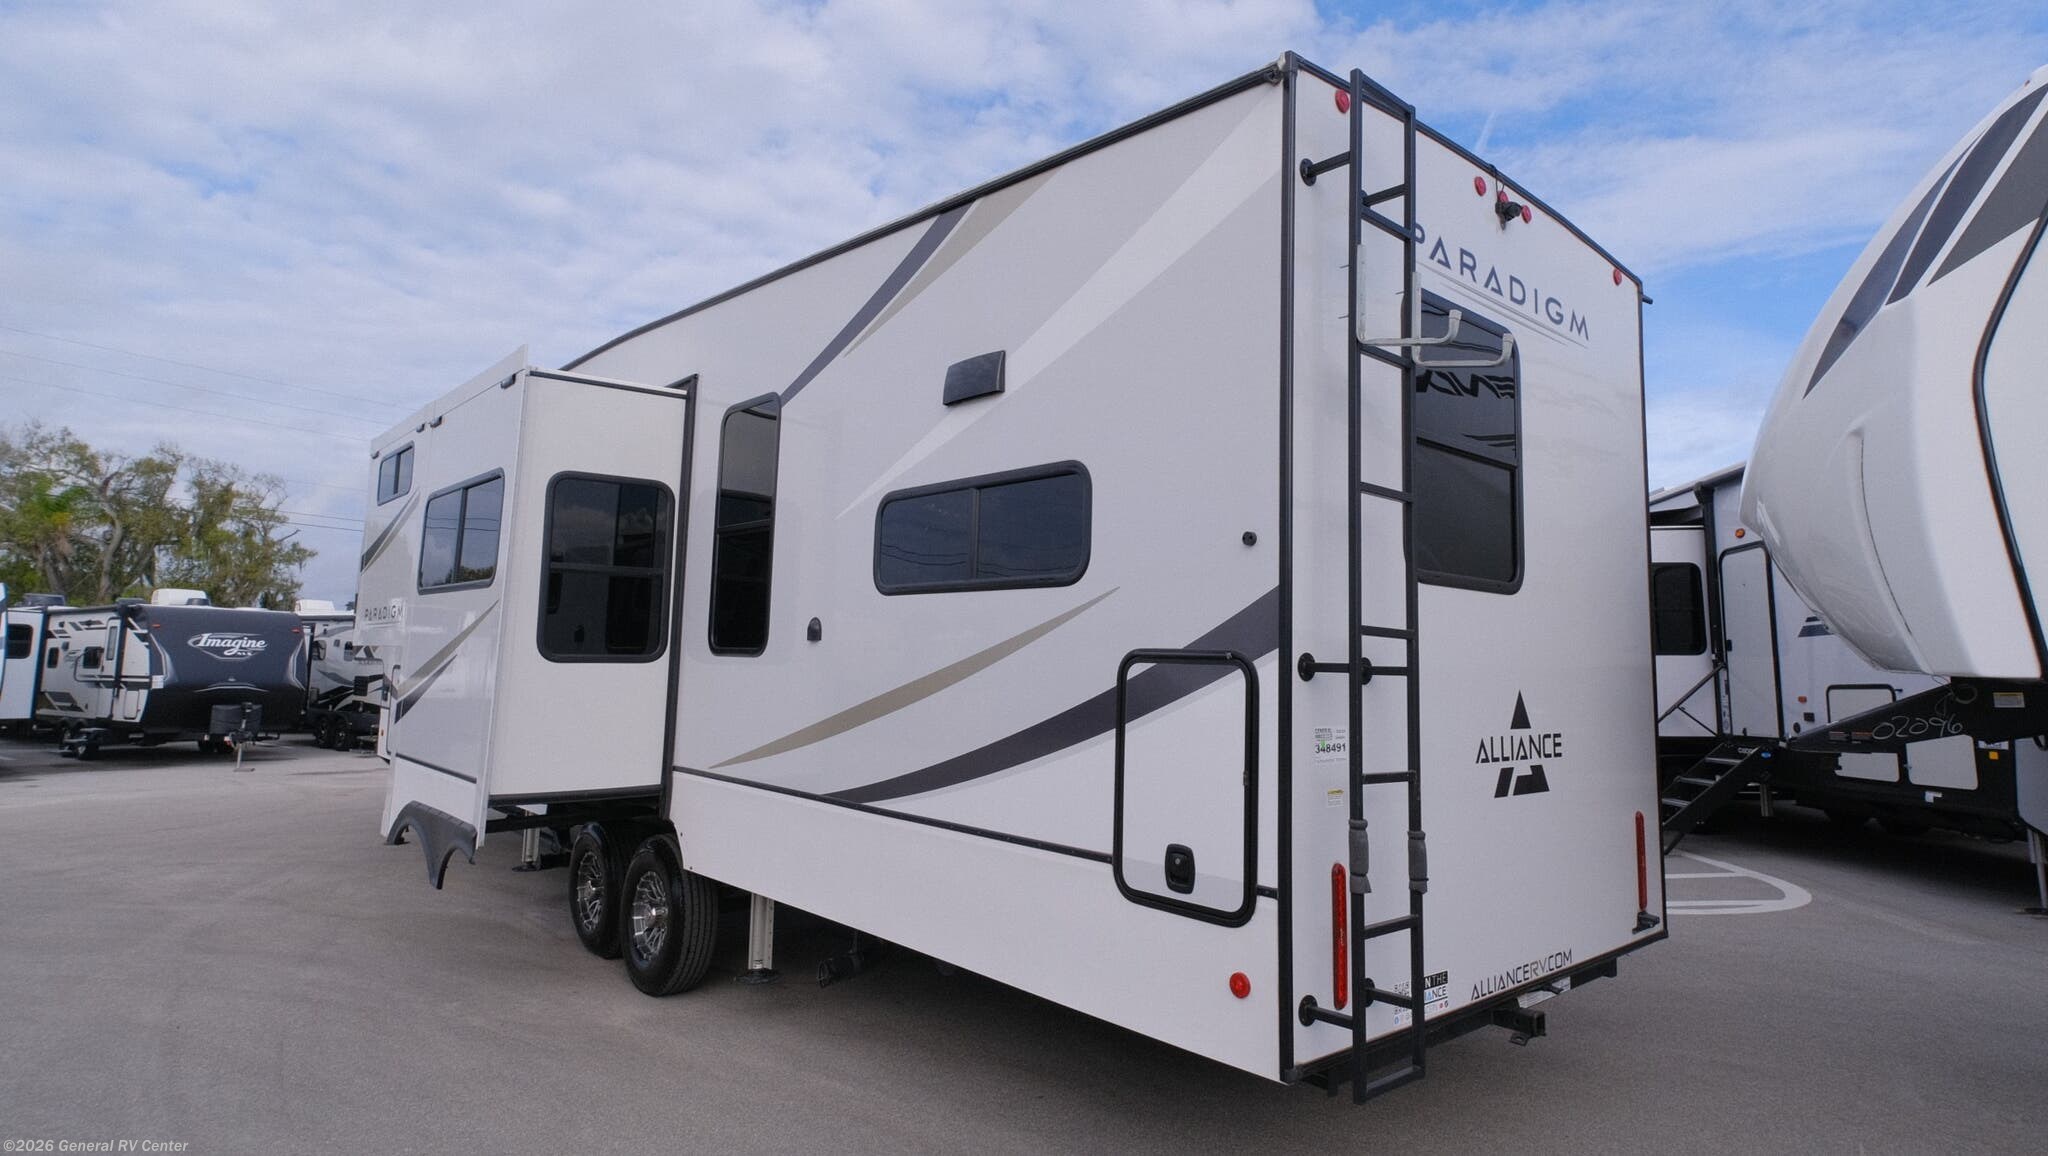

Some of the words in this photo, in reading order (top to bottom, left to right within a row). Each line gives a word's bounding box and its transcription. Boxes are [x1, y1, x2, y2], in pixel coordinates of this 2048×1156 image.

[1415, 222, 1589, 340] PARADIGM
[195, 632, 267, 656] Imagine
[1872, 714, 1963, 740] 02096
[1315, 743, 1346, 754] 348491
[1475, 733, 1563, 764] ALLIANCE
[1470, 948, 1573, 1001] ALLIANCERV.COM
